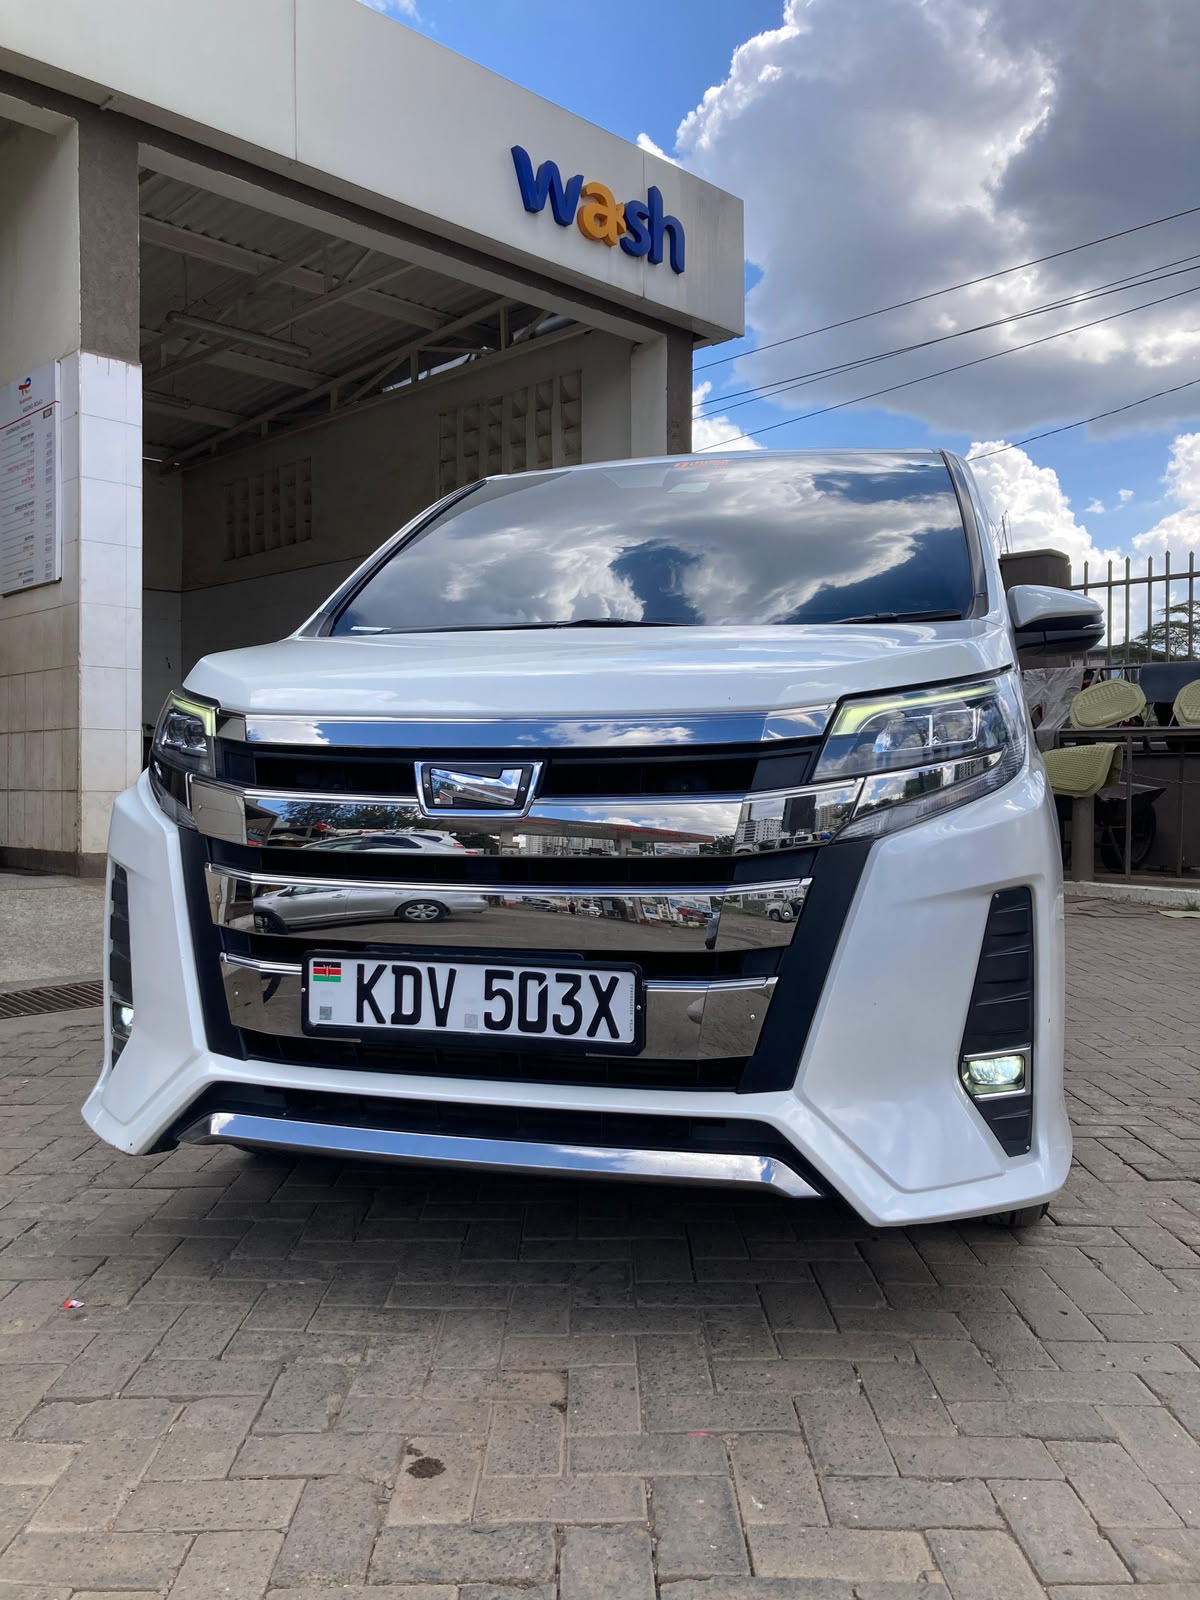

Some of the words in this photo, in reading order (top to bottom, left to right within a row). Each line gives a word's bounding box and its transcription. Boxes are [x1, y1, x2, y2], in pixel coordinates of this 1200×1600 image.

[511, 145, 685, 275] wash
[356, 963, 457, 1027] KDV
[484, 968, 620, 1039] 503X
